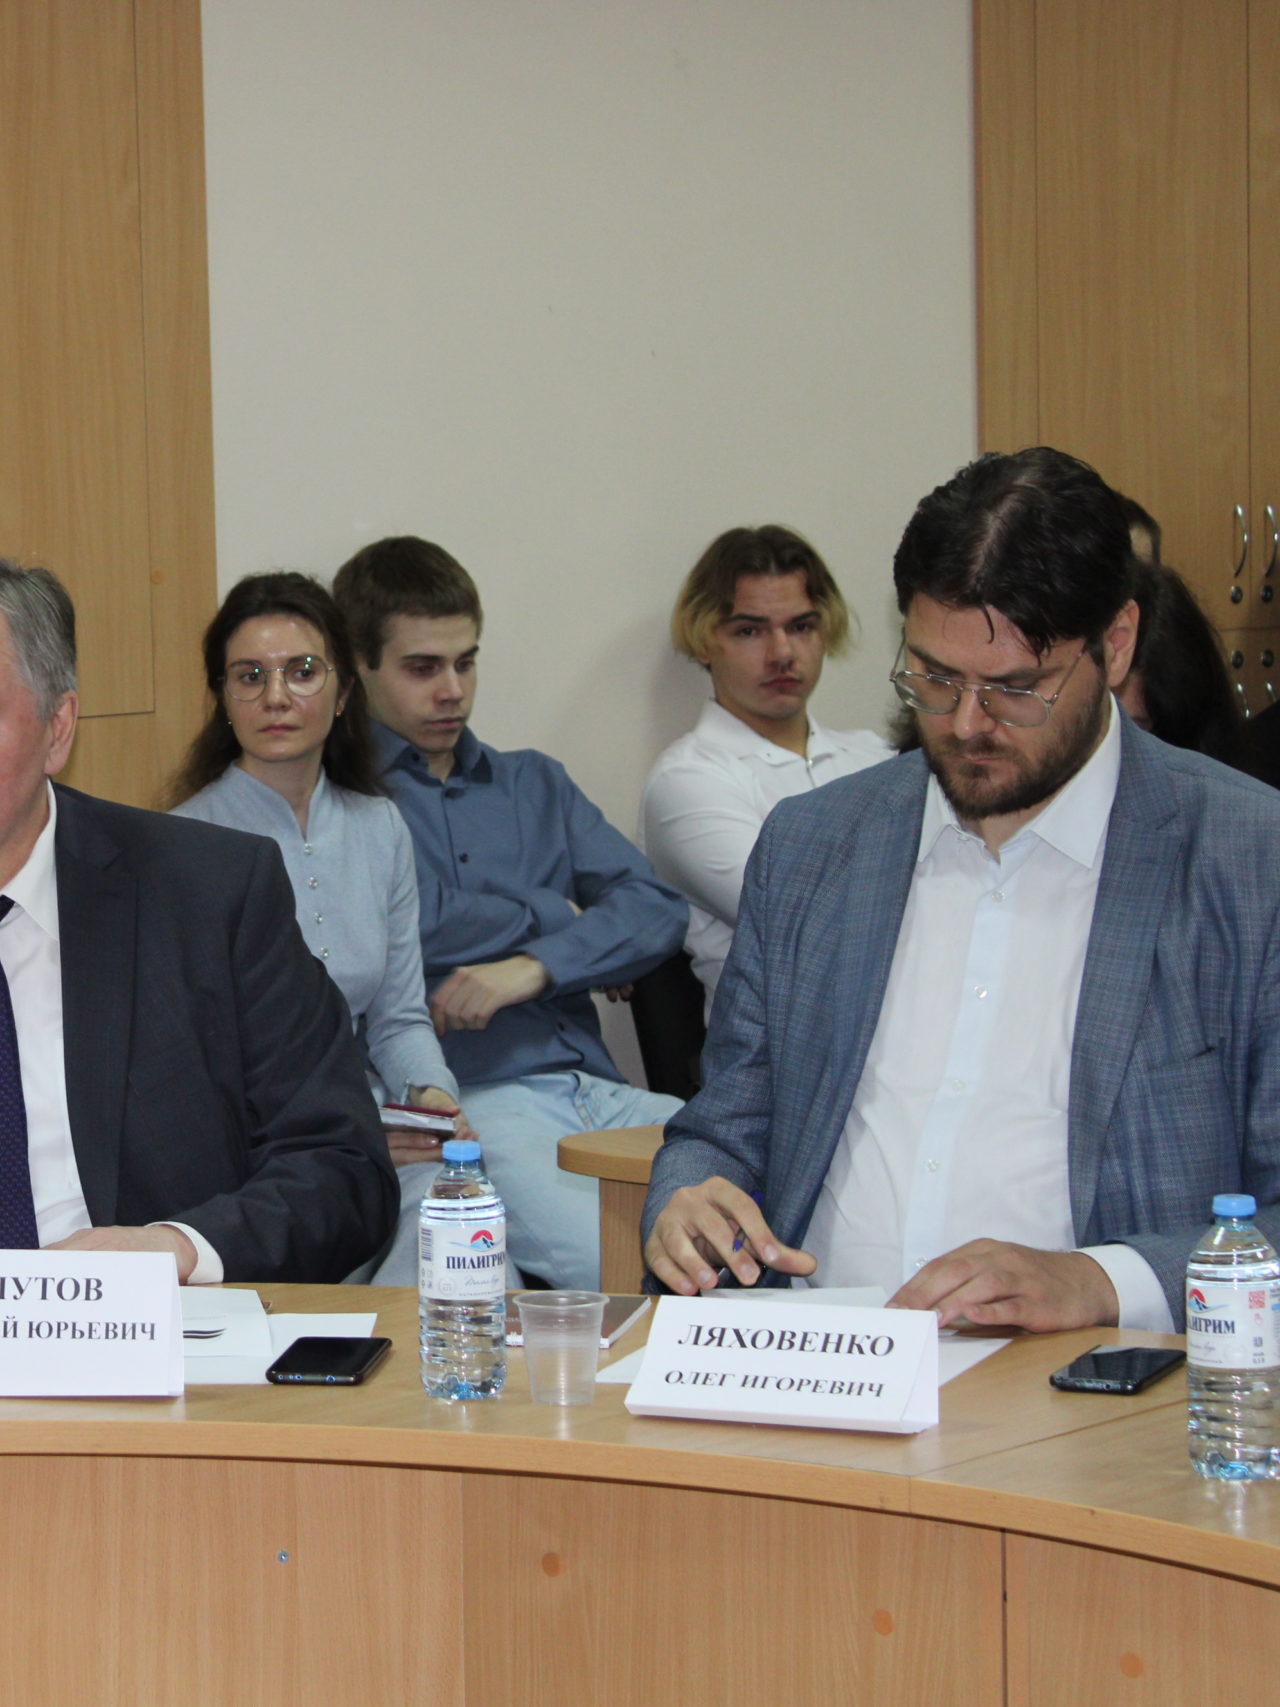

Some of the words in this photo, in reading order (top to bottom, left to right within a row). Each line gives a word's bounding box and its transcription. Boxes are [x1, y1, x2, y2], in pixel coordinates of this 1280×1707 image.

[446, 1251, 506, 1269] ПИЛИГРИ
[27, 1320, 156, 1341] ЮРЬЕВИЧ
[677, 1324, 895, 1357] ЛЯХОВЕНКО
[664, 1370, 736, 1387] ОЛЕГ
[740, 1374, 885, 1398] ИГОРЕВИЧ
